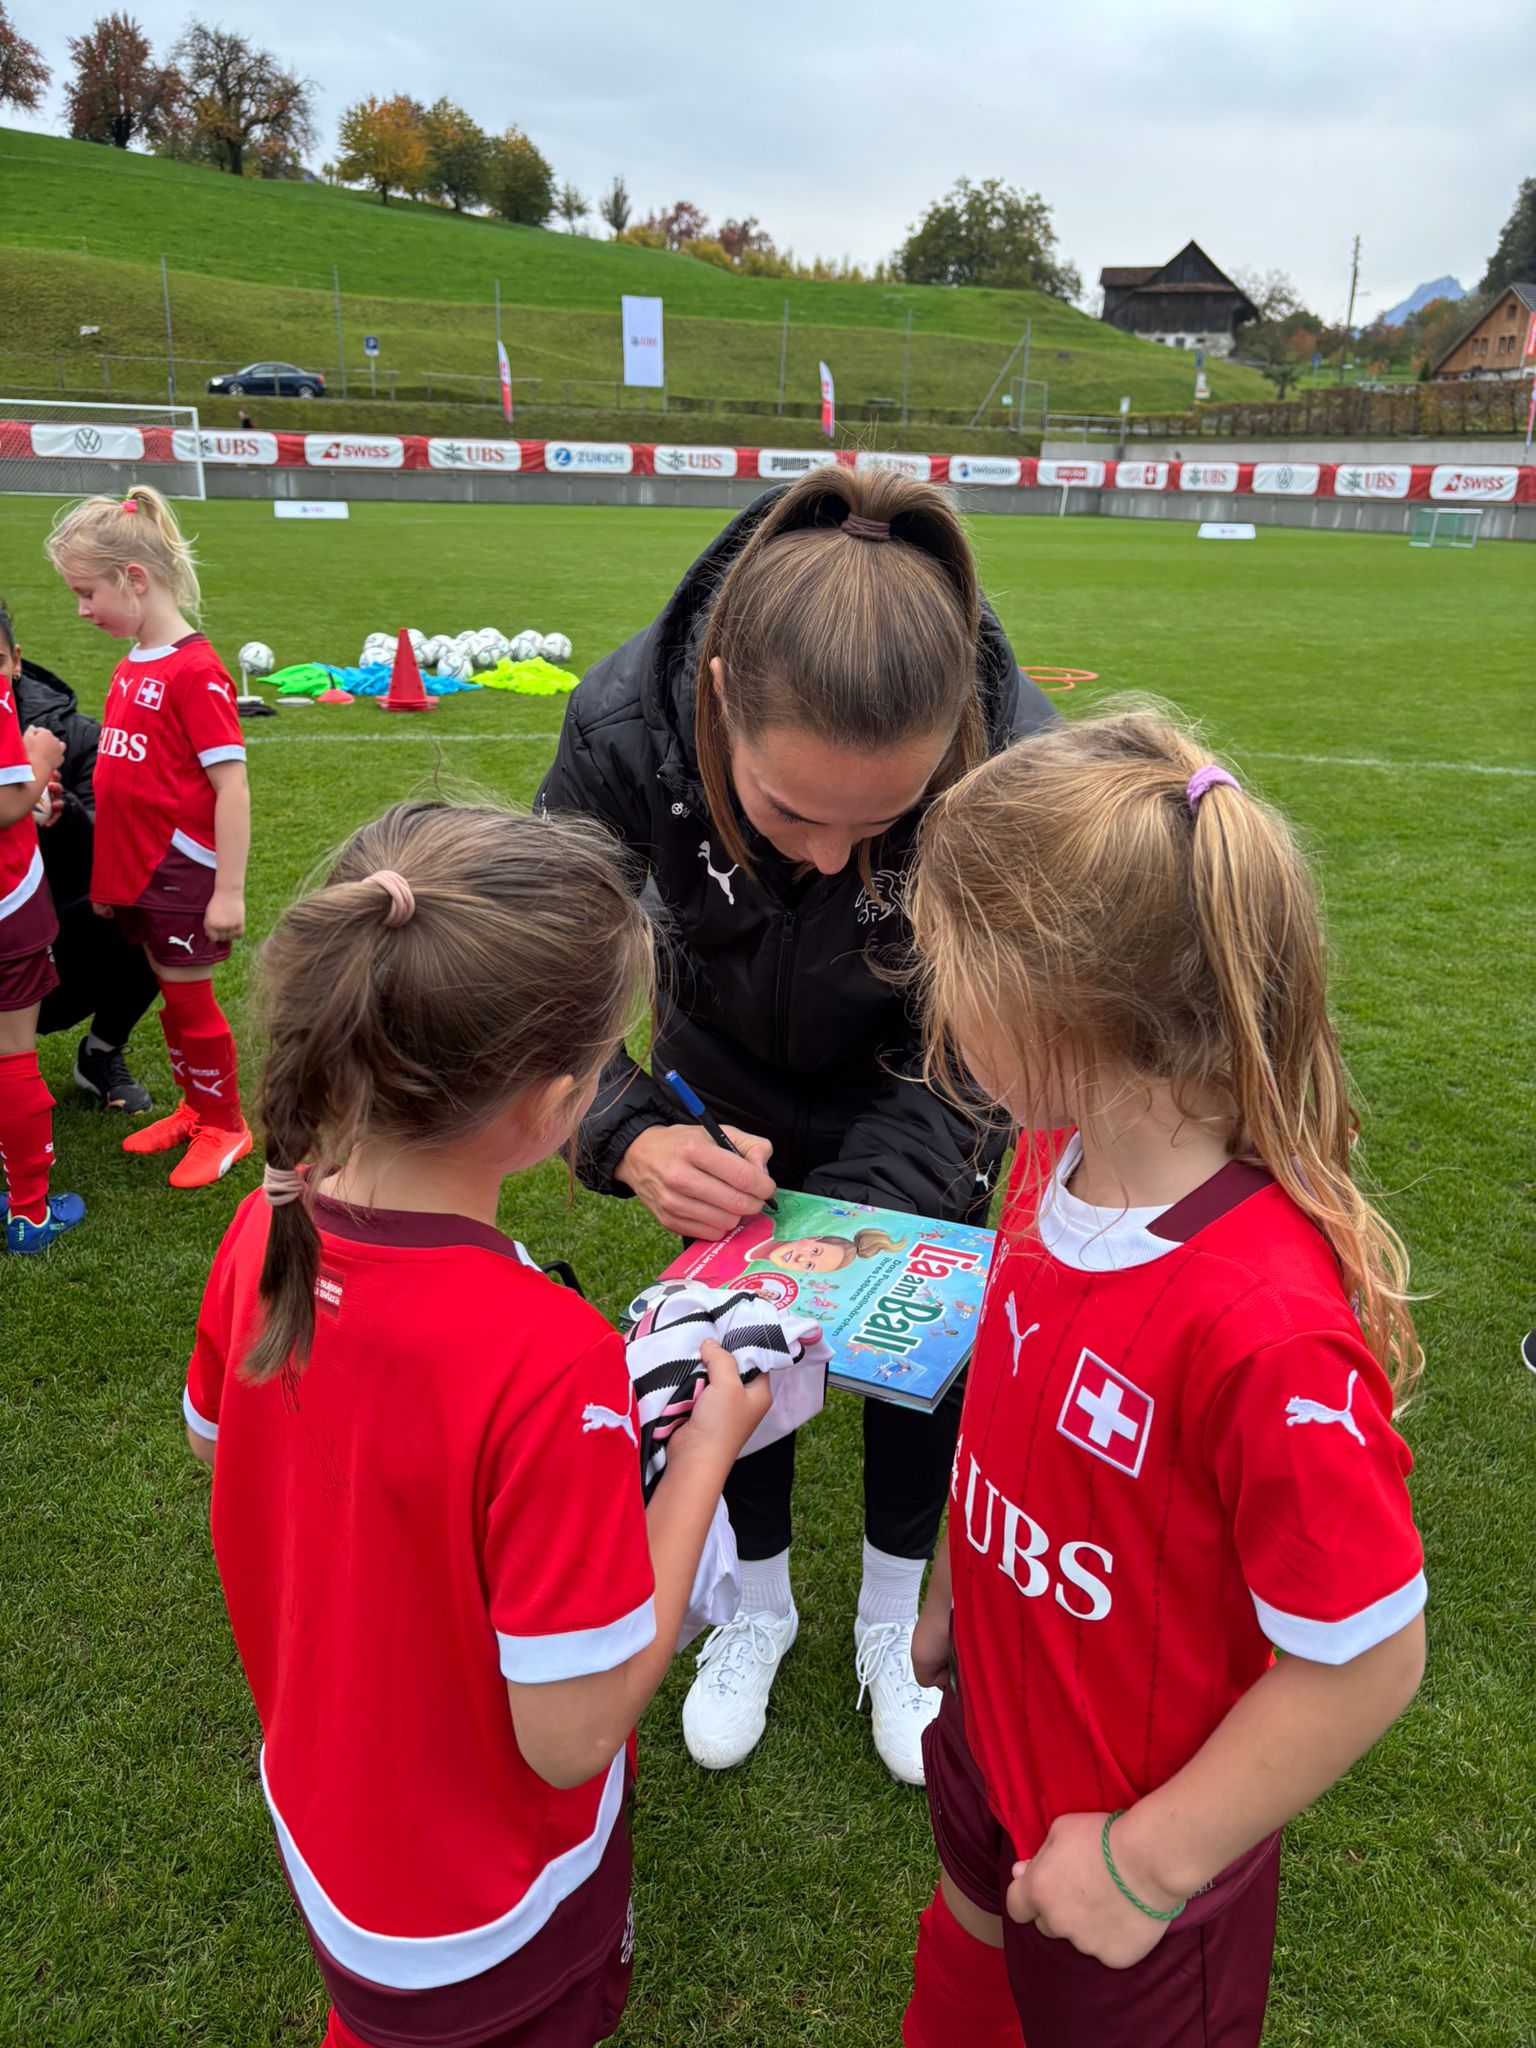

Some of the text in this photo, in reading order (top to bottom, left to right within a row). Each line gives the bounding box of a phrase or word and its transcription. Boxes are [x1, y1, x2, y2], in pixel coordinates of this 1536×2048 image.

[215, 437, 260, 457] UBS
[343, 443, 390, 459] SWISS
[466, 445, 505, 464] UBS
[576, 451, 625, 465] ZURICH
[688, 453, 723, 470] UBS
[972, 465, 1013, 476] swisscom
[1203, 469, 1227, 485] UBS
[1364, 471, 1396, 491] UBS
[1462, 476, 1504, 492] SWISS
[101, 727, 148, 763] UBS
[852, 1243, 981, 1354] Lia am Ball
[965, 1451, 1113, 1621] UBS
